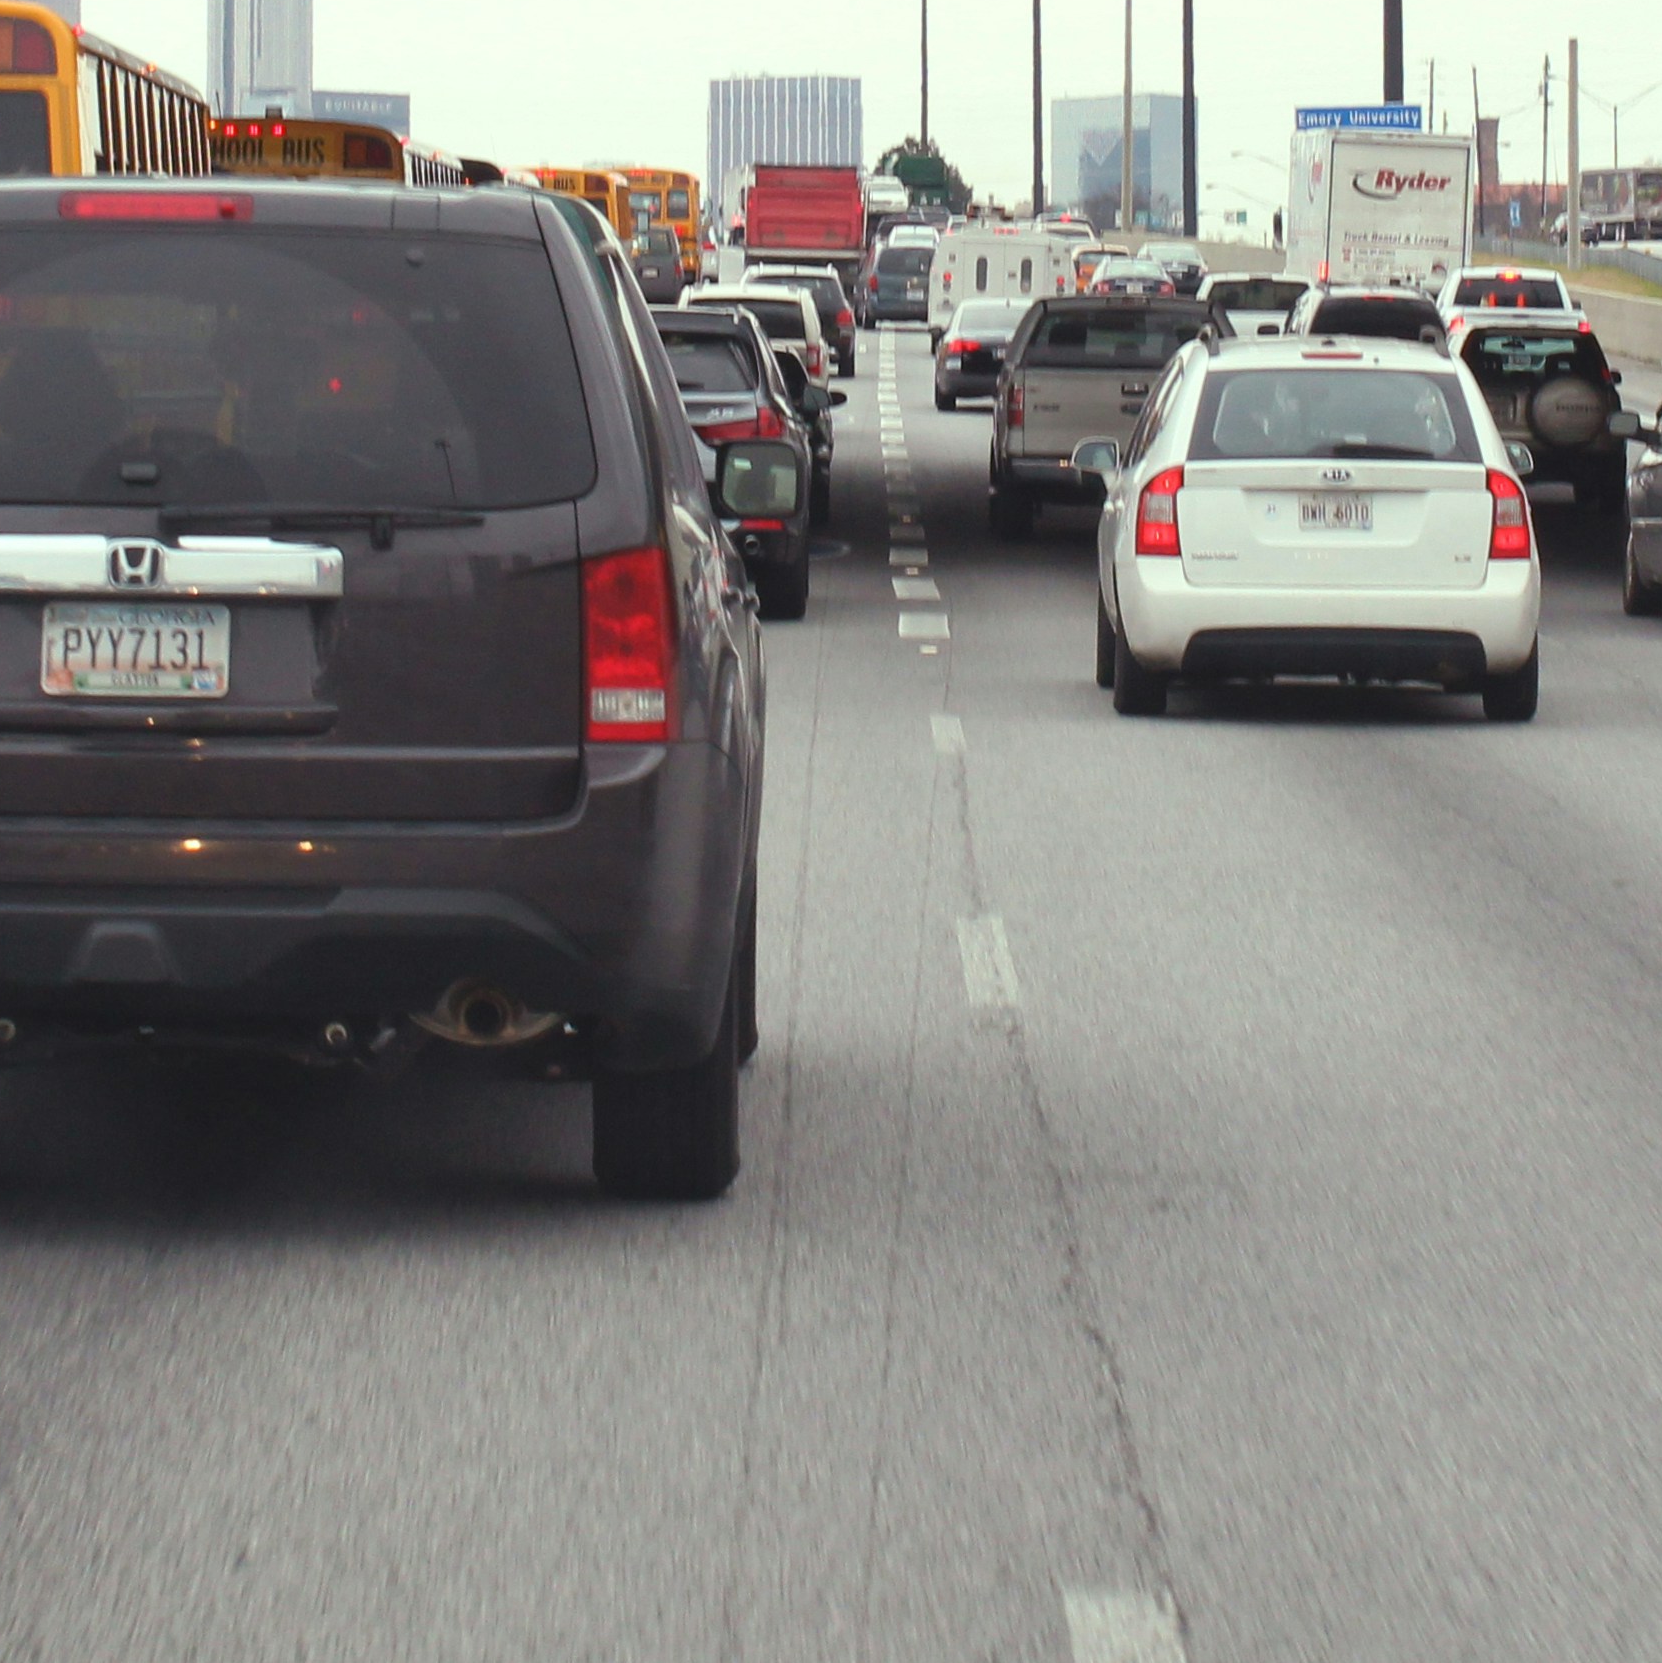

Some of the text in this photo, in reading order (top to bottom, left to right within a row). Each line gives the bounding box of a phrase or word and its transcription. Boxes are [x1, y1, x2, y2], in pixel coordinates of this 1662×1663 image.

[1298, 109, 1420, 128] Emory University
[282, 138, 325, 167] BUS
[1374, 167, 1452, 194] Ryder
[1343, 231, 1369, 242] Truck
[1370, 232, 1402, 245] Rental
[1414, 234, 1450, 247] Leasing
[61, 627, 210, 671] PYY7131
